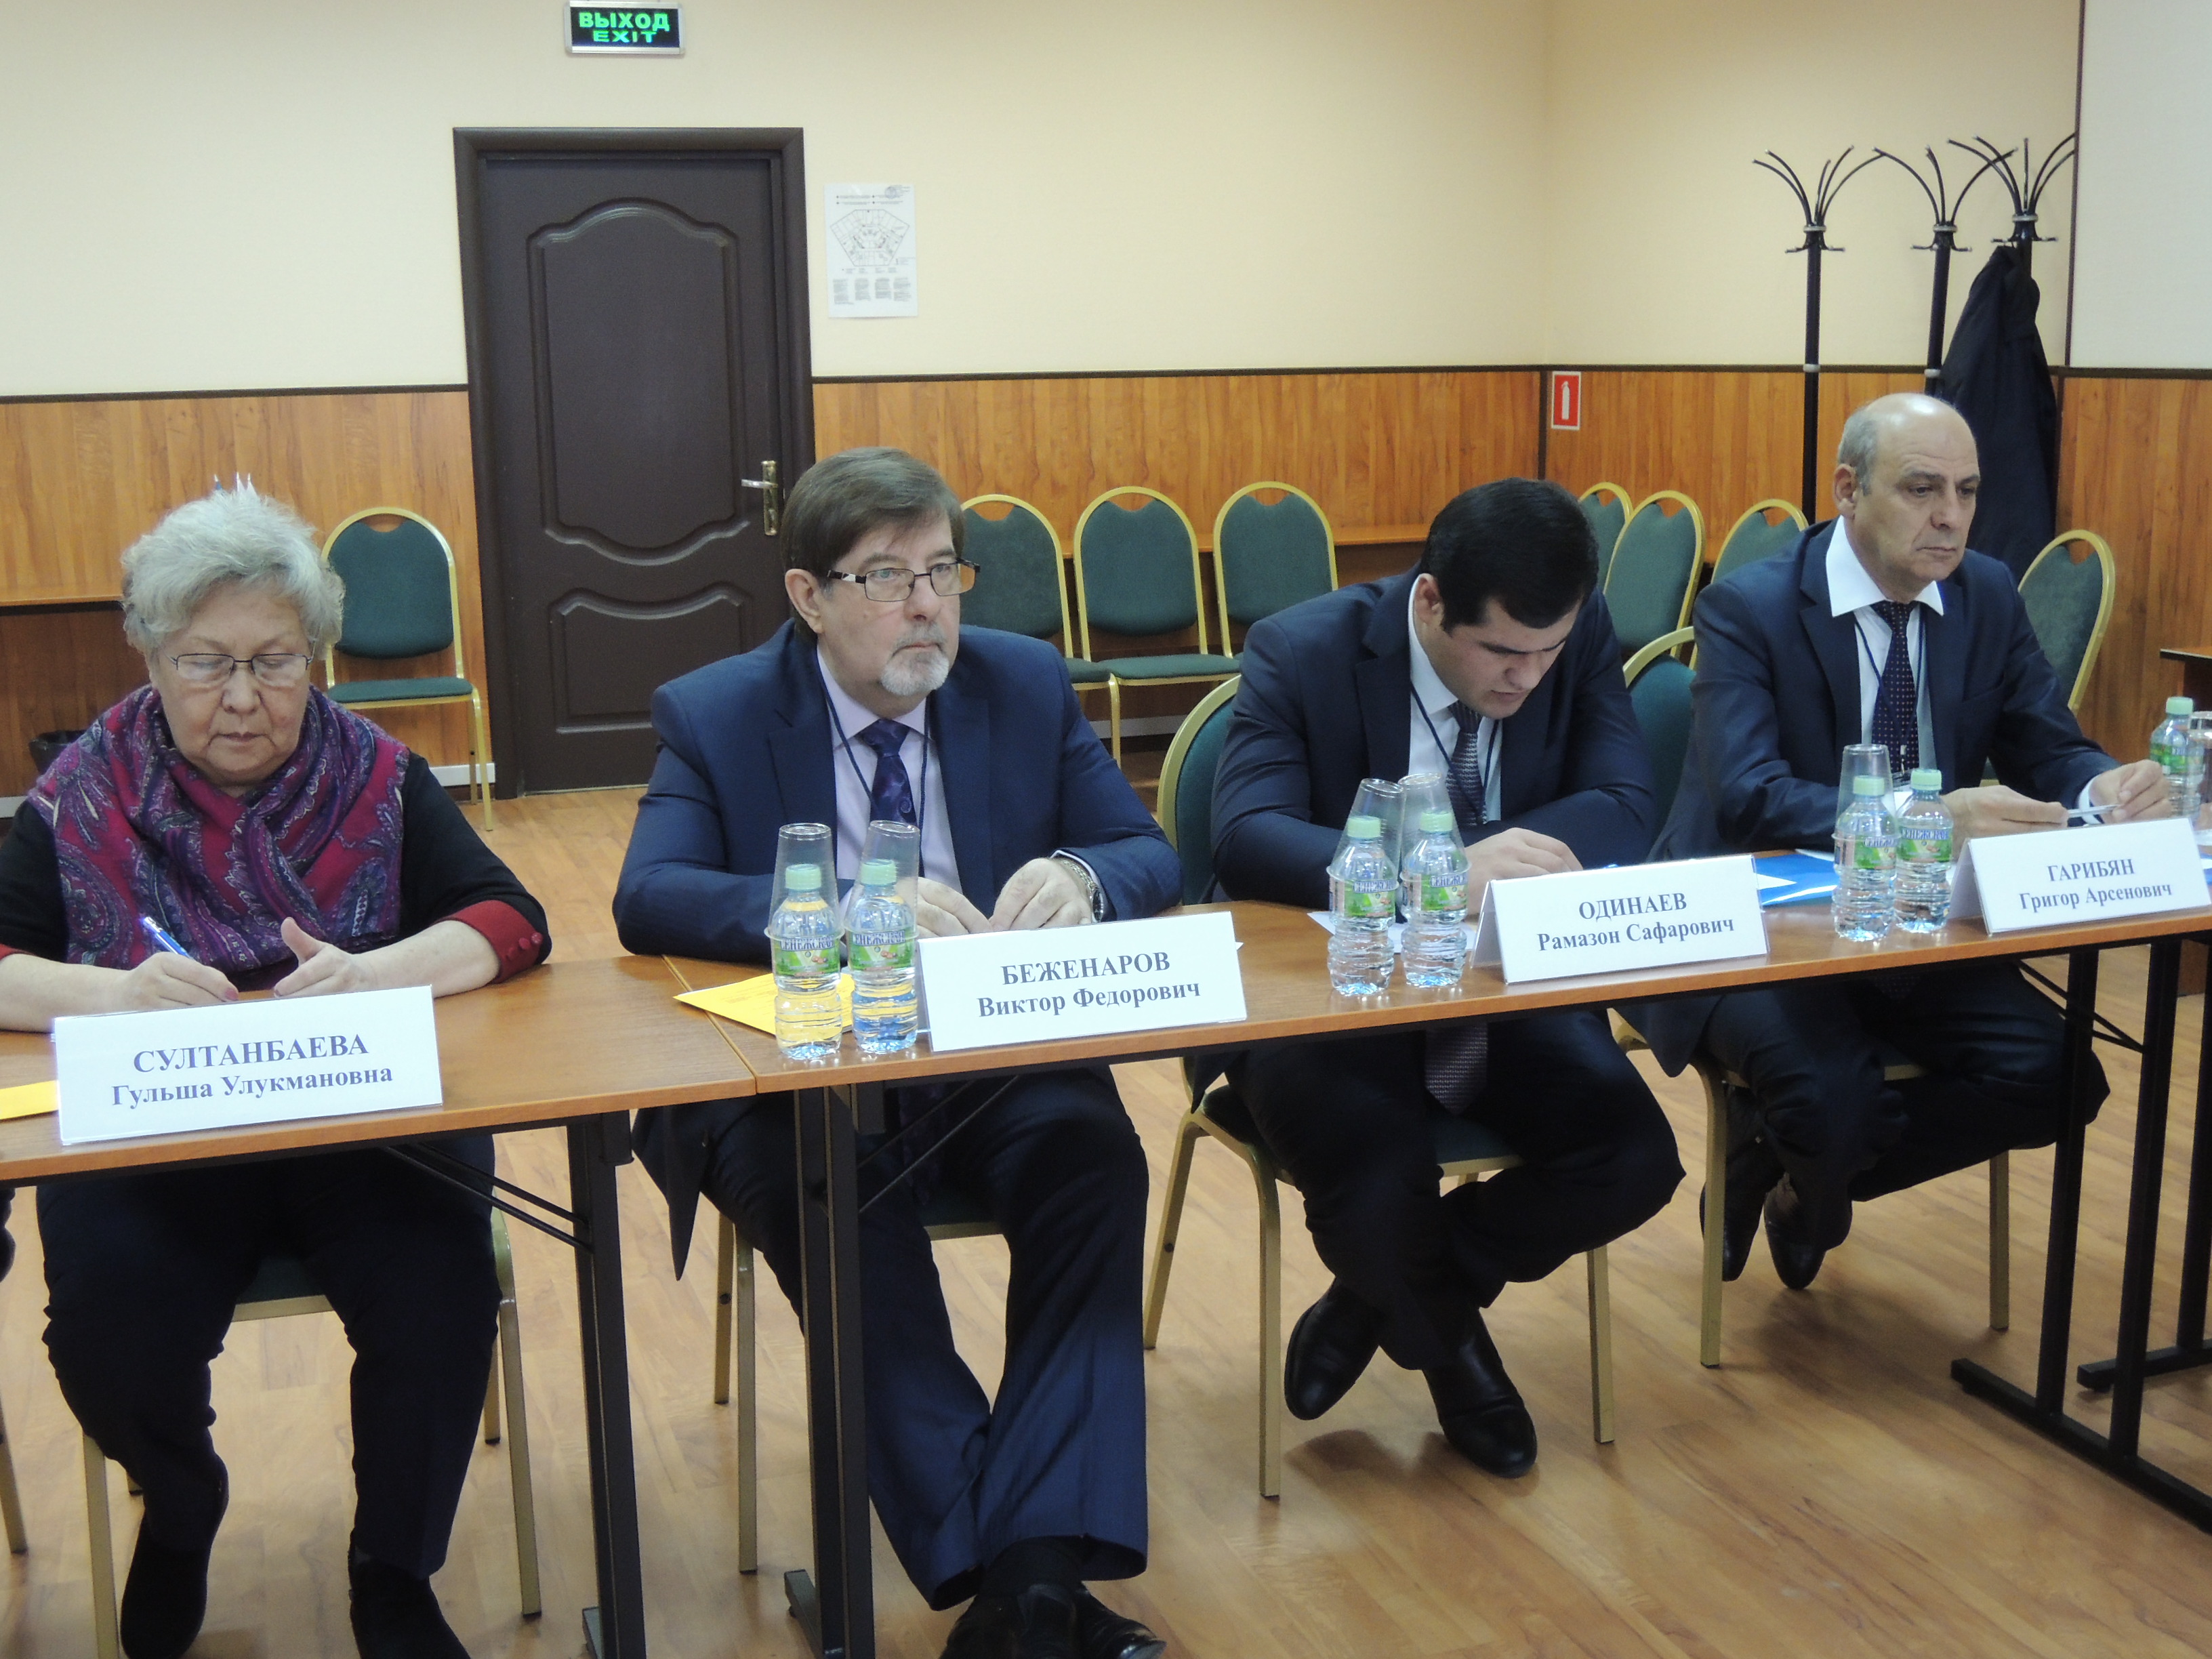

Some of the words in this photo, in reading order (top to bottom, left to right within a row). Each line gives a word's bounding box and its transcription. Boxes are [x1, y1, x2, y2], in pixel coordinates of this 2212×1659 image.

[579, 12, 670, 32] ВЫХОД
[593, 30, 657, 43] EXIT
[2047, 858, 2135, 882] ГАРИБЯН
[1578, 893, 1687, 922] ОДИНАЕВ
[2019, 890, 2081, 914] Григор
[2085, 884, 2173, 907] Арсенович
[1536, 930, 1621, 951] Рамазон
[1626, 919, 1734, 944] Сафарович
[1000, 951, 1170, 985] БЕЖЕНАРОВ
[977, 995, 1066, 1017] Виктор
[1073, 983, 1201, 1008] Федорович
[133, 1033, 369, 1073] СУЛТАНБАЕВА
[111, 1084, 213, 1110] Гульша
[220, 1068, 393, 1099] Улукмановна
